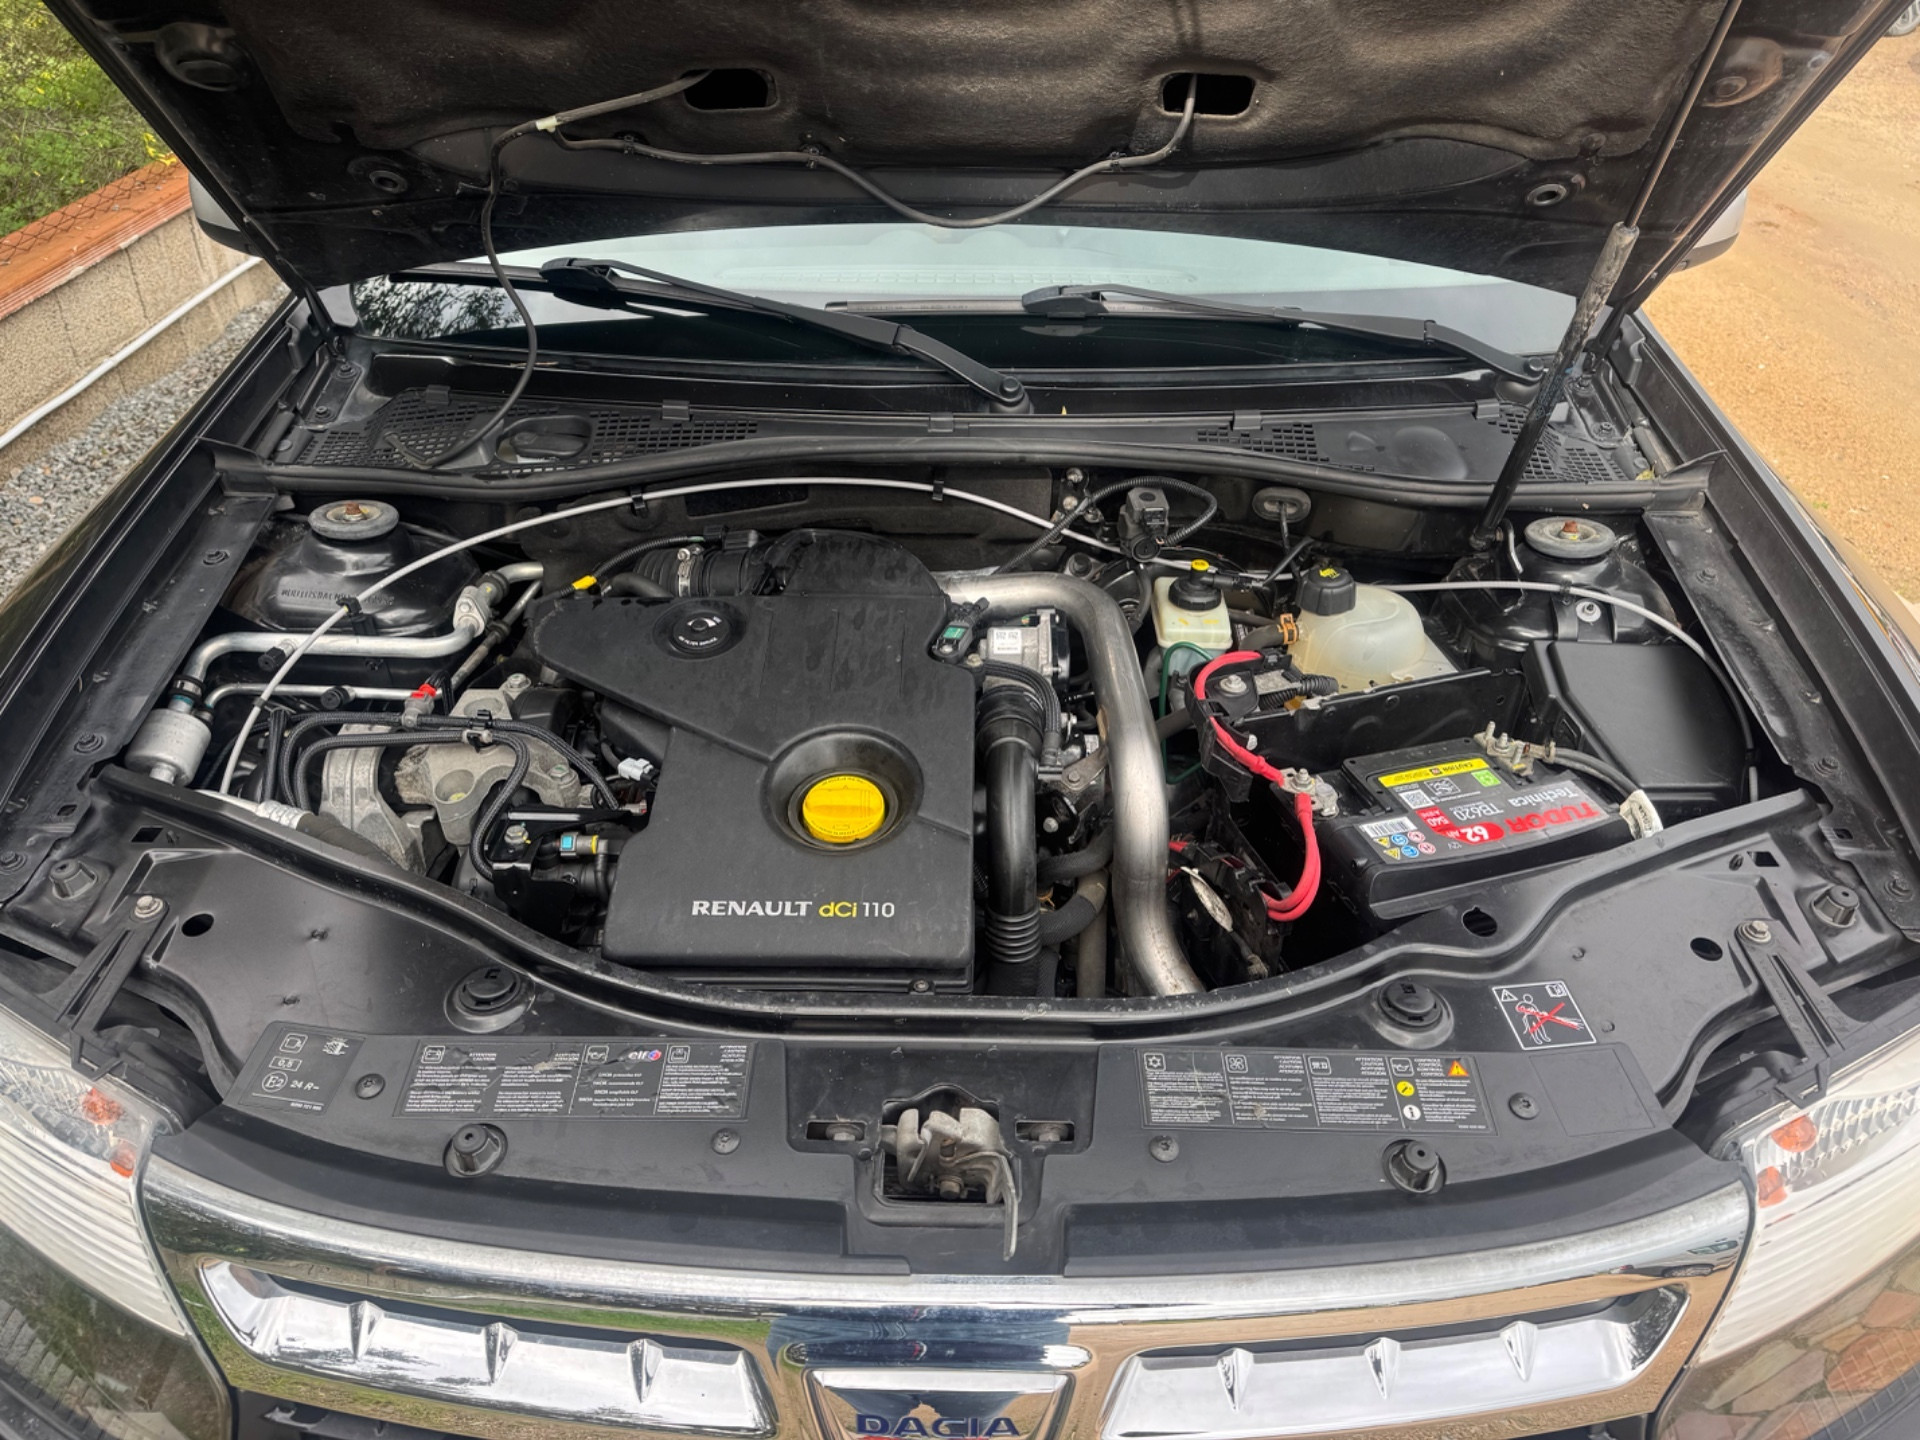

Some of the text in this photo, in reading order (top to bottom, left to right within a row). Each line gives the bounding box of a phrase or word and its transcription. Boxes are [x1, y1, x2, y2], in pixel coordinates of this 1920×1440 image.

[1507, 786, 1579, 808] Technica
[1451, 802, 1504, 821] TB620
[1504, 802, 1600, 835] TUDOR
[1460, 825, 1489, 842] 62
[691, 900, 895, 918] RENAULT dCi 110
[278, 1059, 294, 1068] 0,5
[628, 1050, 648, 1061] elf
[265, 1075, 284, 1088] E2
[290, 1080, 303, 1089] 24
[856, 1413, 1020, 1437] DACIA
